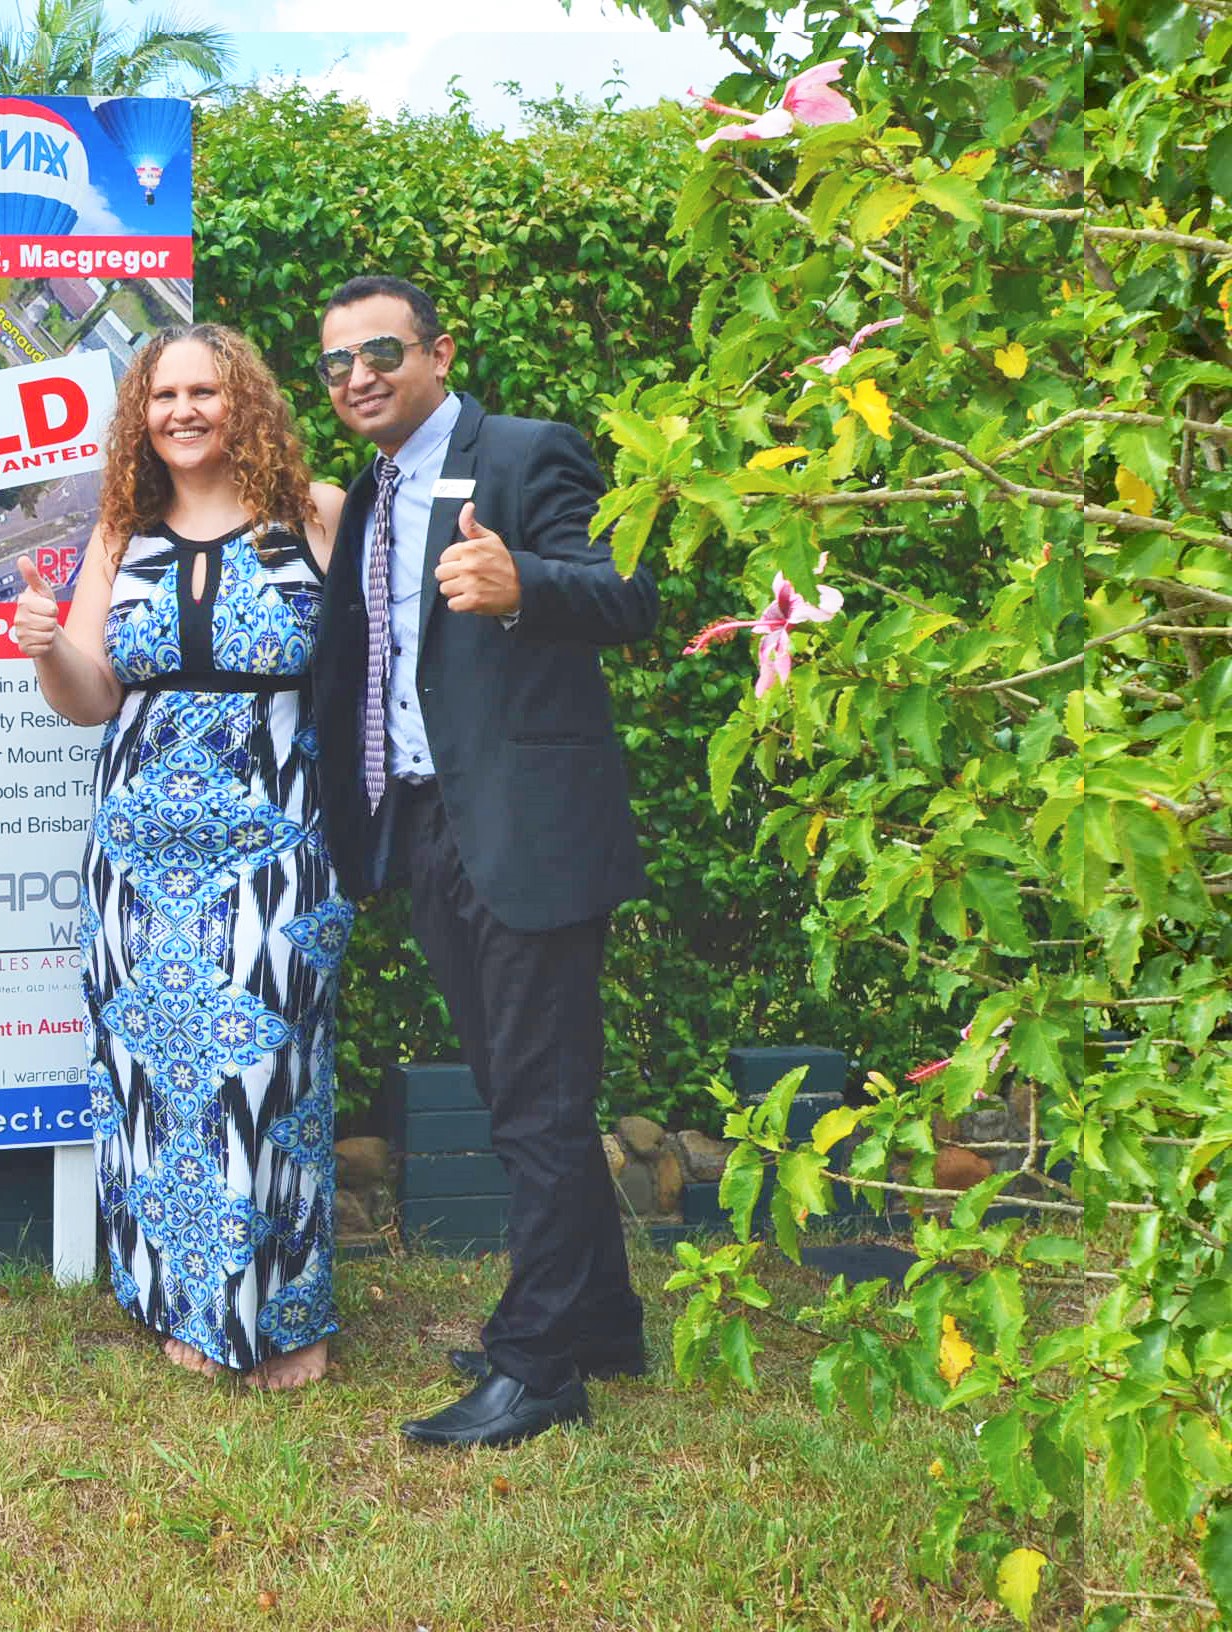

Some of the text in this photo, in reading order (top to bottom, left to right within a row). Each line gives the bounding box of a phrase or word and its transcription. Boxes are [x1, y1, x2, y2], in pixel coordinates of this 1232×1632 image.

[20, 245, 170, 275] Macgregor
[18, 680, 29, 693] a
[8, 747, 64, 764] Mount
[34, 781, 66, 798] and
[17, 1020, 32, 1036] in
